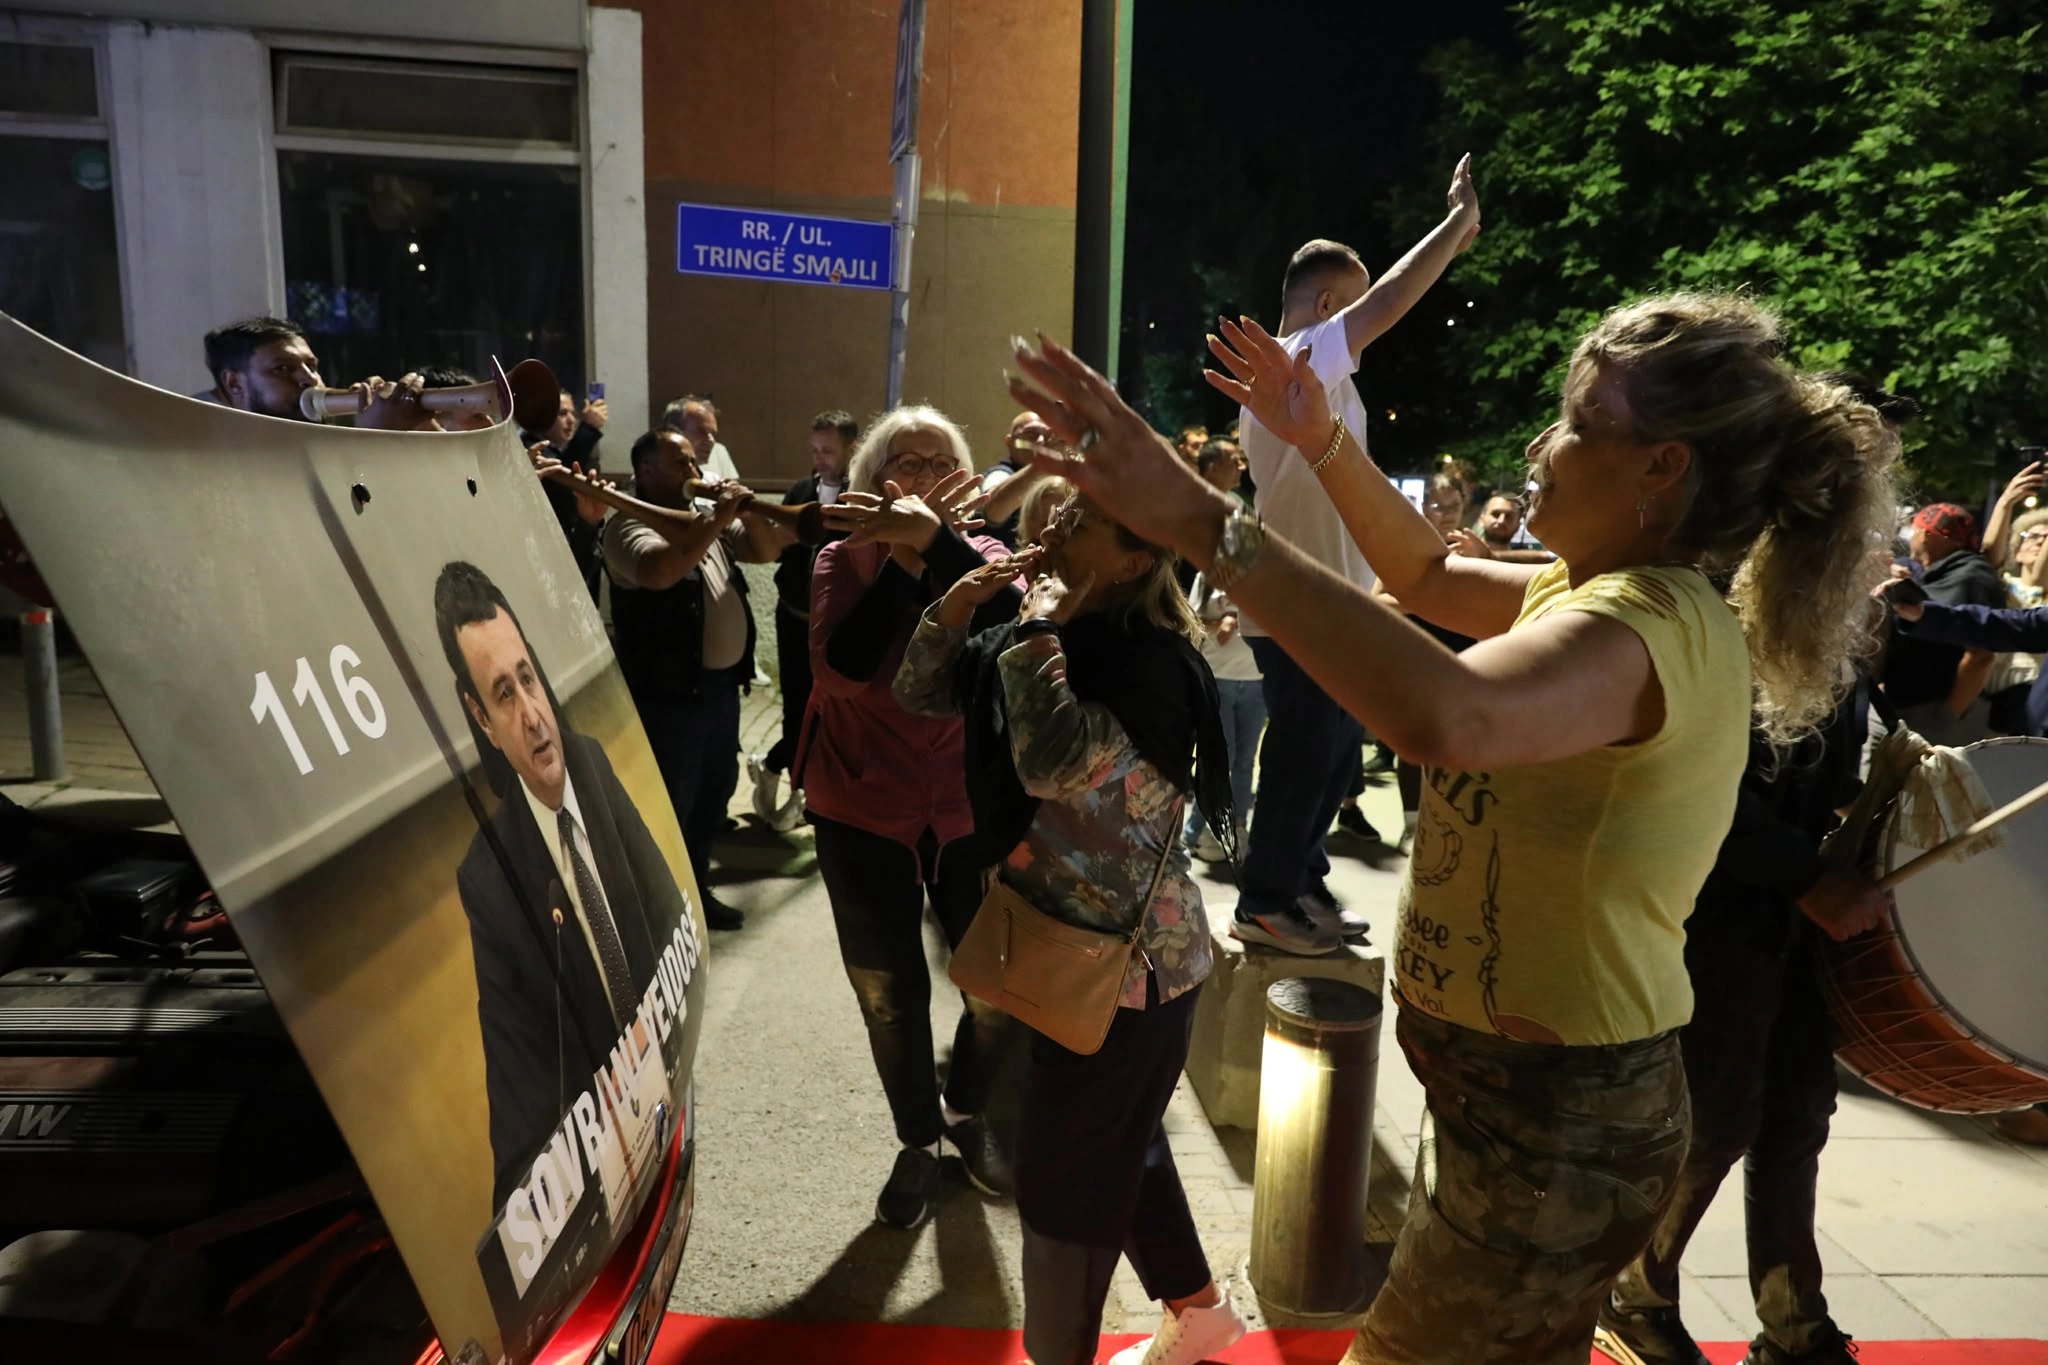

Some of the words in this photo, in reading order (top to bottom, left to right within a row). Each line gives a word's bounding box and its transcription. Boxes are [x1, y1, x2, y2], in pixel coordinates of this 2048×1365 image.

[742, 219, 776, 241] RR.
[782, 222, 794, 246] /
[799, 226, 832, 247] UL.
[694, 244, 786, 273] TRINGË
[792, 253, 878, 281] SMAJLI
[250, 644, 387, 776] 116
